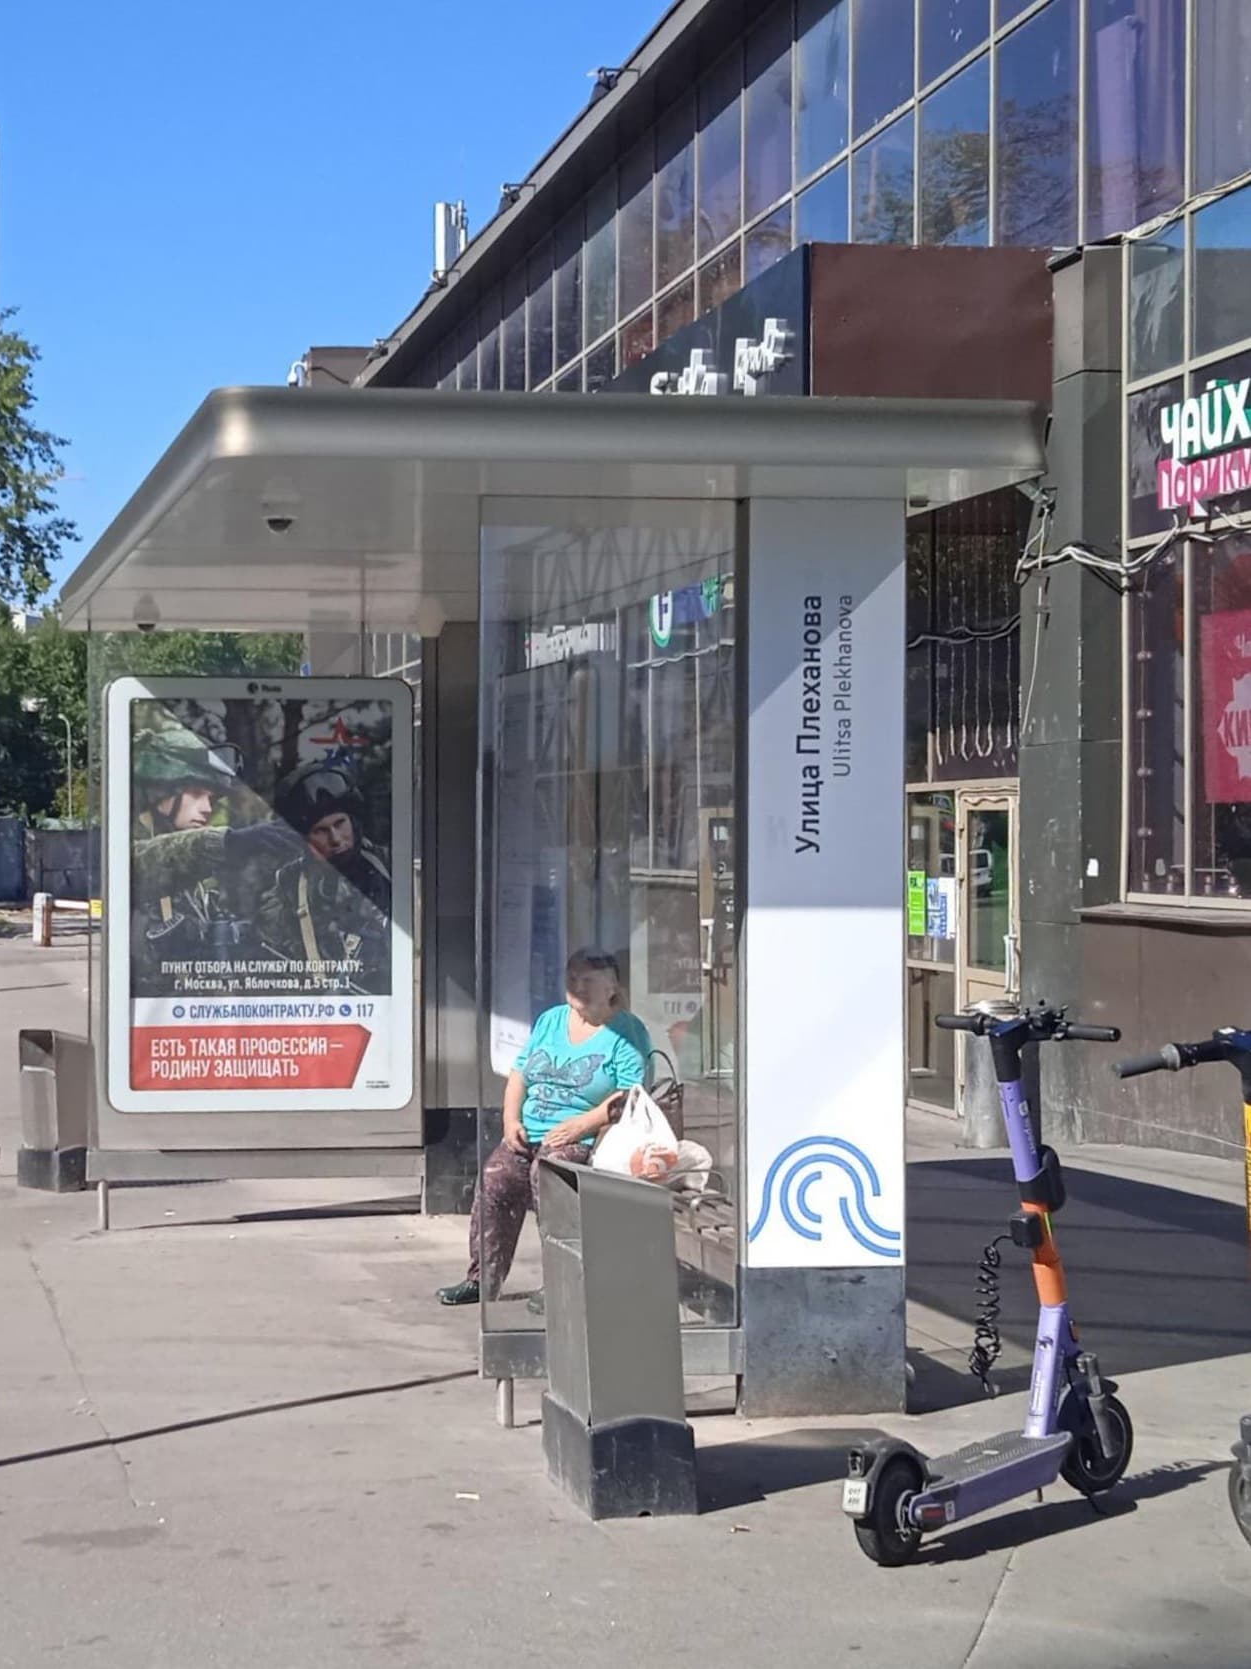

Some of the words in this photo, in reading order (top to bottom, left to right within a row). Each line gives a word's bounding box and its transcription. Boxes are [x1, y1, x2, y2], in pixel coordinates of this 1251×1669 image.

[1161, 378, 1251, 460] ЧАЙХ
[833, 594, 853, 712] Plekhanova
[796, 595, 823, 755] Плеханова
[832, 717, 852, 777] Ulitsa
[1223, 710, 1251, 747] КИ
[795, 764, 824, 854] Улица
[161, 960, 194, 974] ПУНКТ
[194, 960, 233, 974] ОТБОРА
[234, 960, 247, 973] НА
[248, 959, 288, 974] СЛУЖБУ
[289, 959, 304, 973] ПО
[305, 959, 364, 973] КОНТРАКТУ:
[174, 979, 182, 991] г.
[184, 978, 227, 992] Москва,
[227, 979, 243, 992] ул.
[245, 976, 303, 992] Яблочкова,
[189, 1003, 335, 1019] СЛУЖБАПОКОНТРАКТУ.РФ
[356, 1003, 375, 1018] 117
[151, 1038, 187, 1058] ЕСТЬ
[189, 1038, 237, 1057] ТАКАЯ
[240, 1036, 328, 1056] ПРОФЕССИЯ
[151, 1059, 211, 1079] РОДИНУ
[213, 1058, 300, 1078] ЗАЩИЩАТЬ
